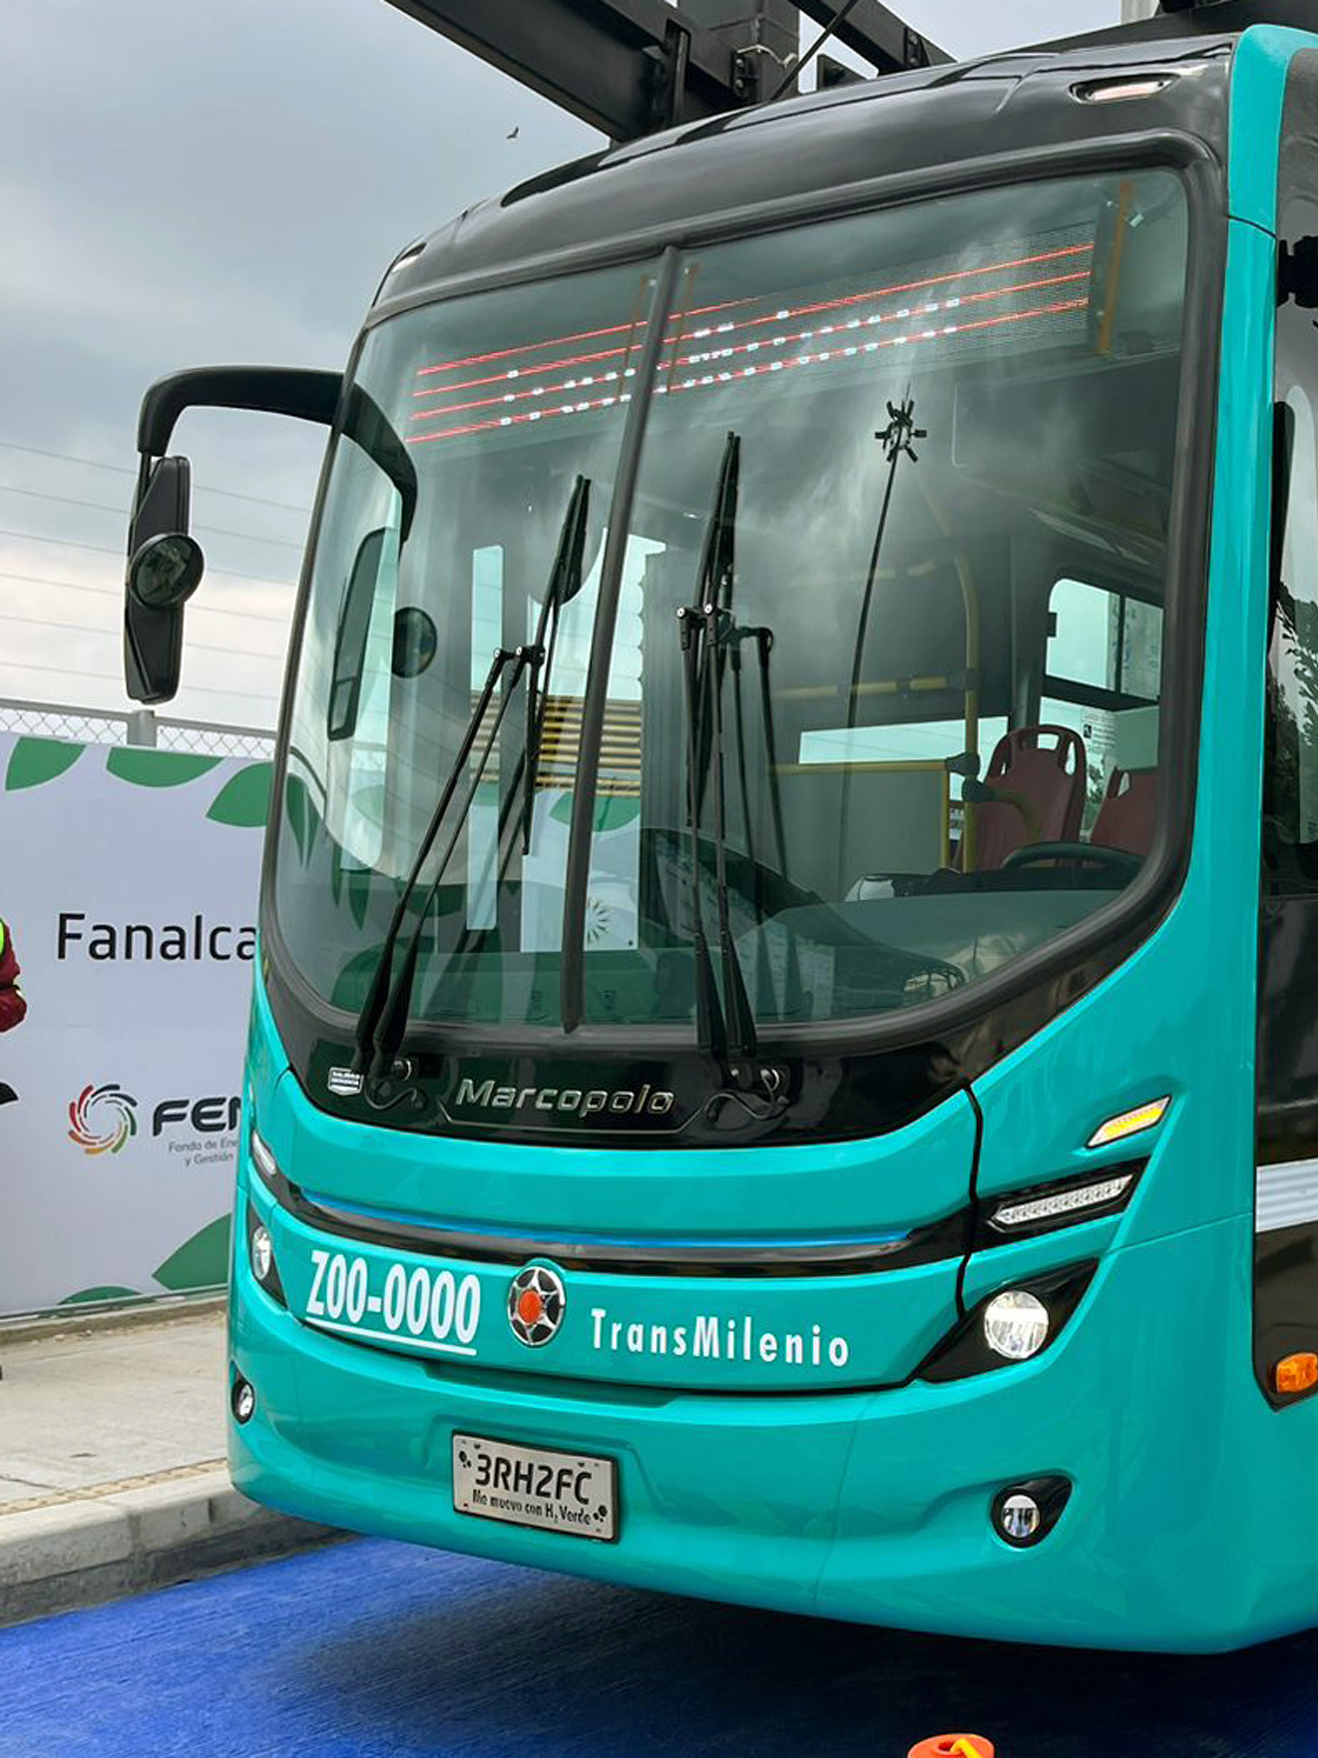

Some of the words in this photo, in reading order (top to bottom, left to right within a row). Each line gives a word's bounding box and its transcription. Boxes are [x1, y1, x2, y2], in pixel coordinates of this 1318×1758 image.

[57, 913, 257, 961] Fanalca
[455, 1078, 674, 1118] Marcopolo
[168, 1140, 202, 1153] Fondo
[204, 1139, 218, 1150] de
[591, 1308, 850, 1368] TransMilenio
[475, 1453, 592, 1505] 3RH2FC
[472, 1489, 487, 1504] Me
[490, 1495, 523, 1512] muevo
[525, 1501, 543, 1516] con
[560, 1505, 592, 1525] Verde
